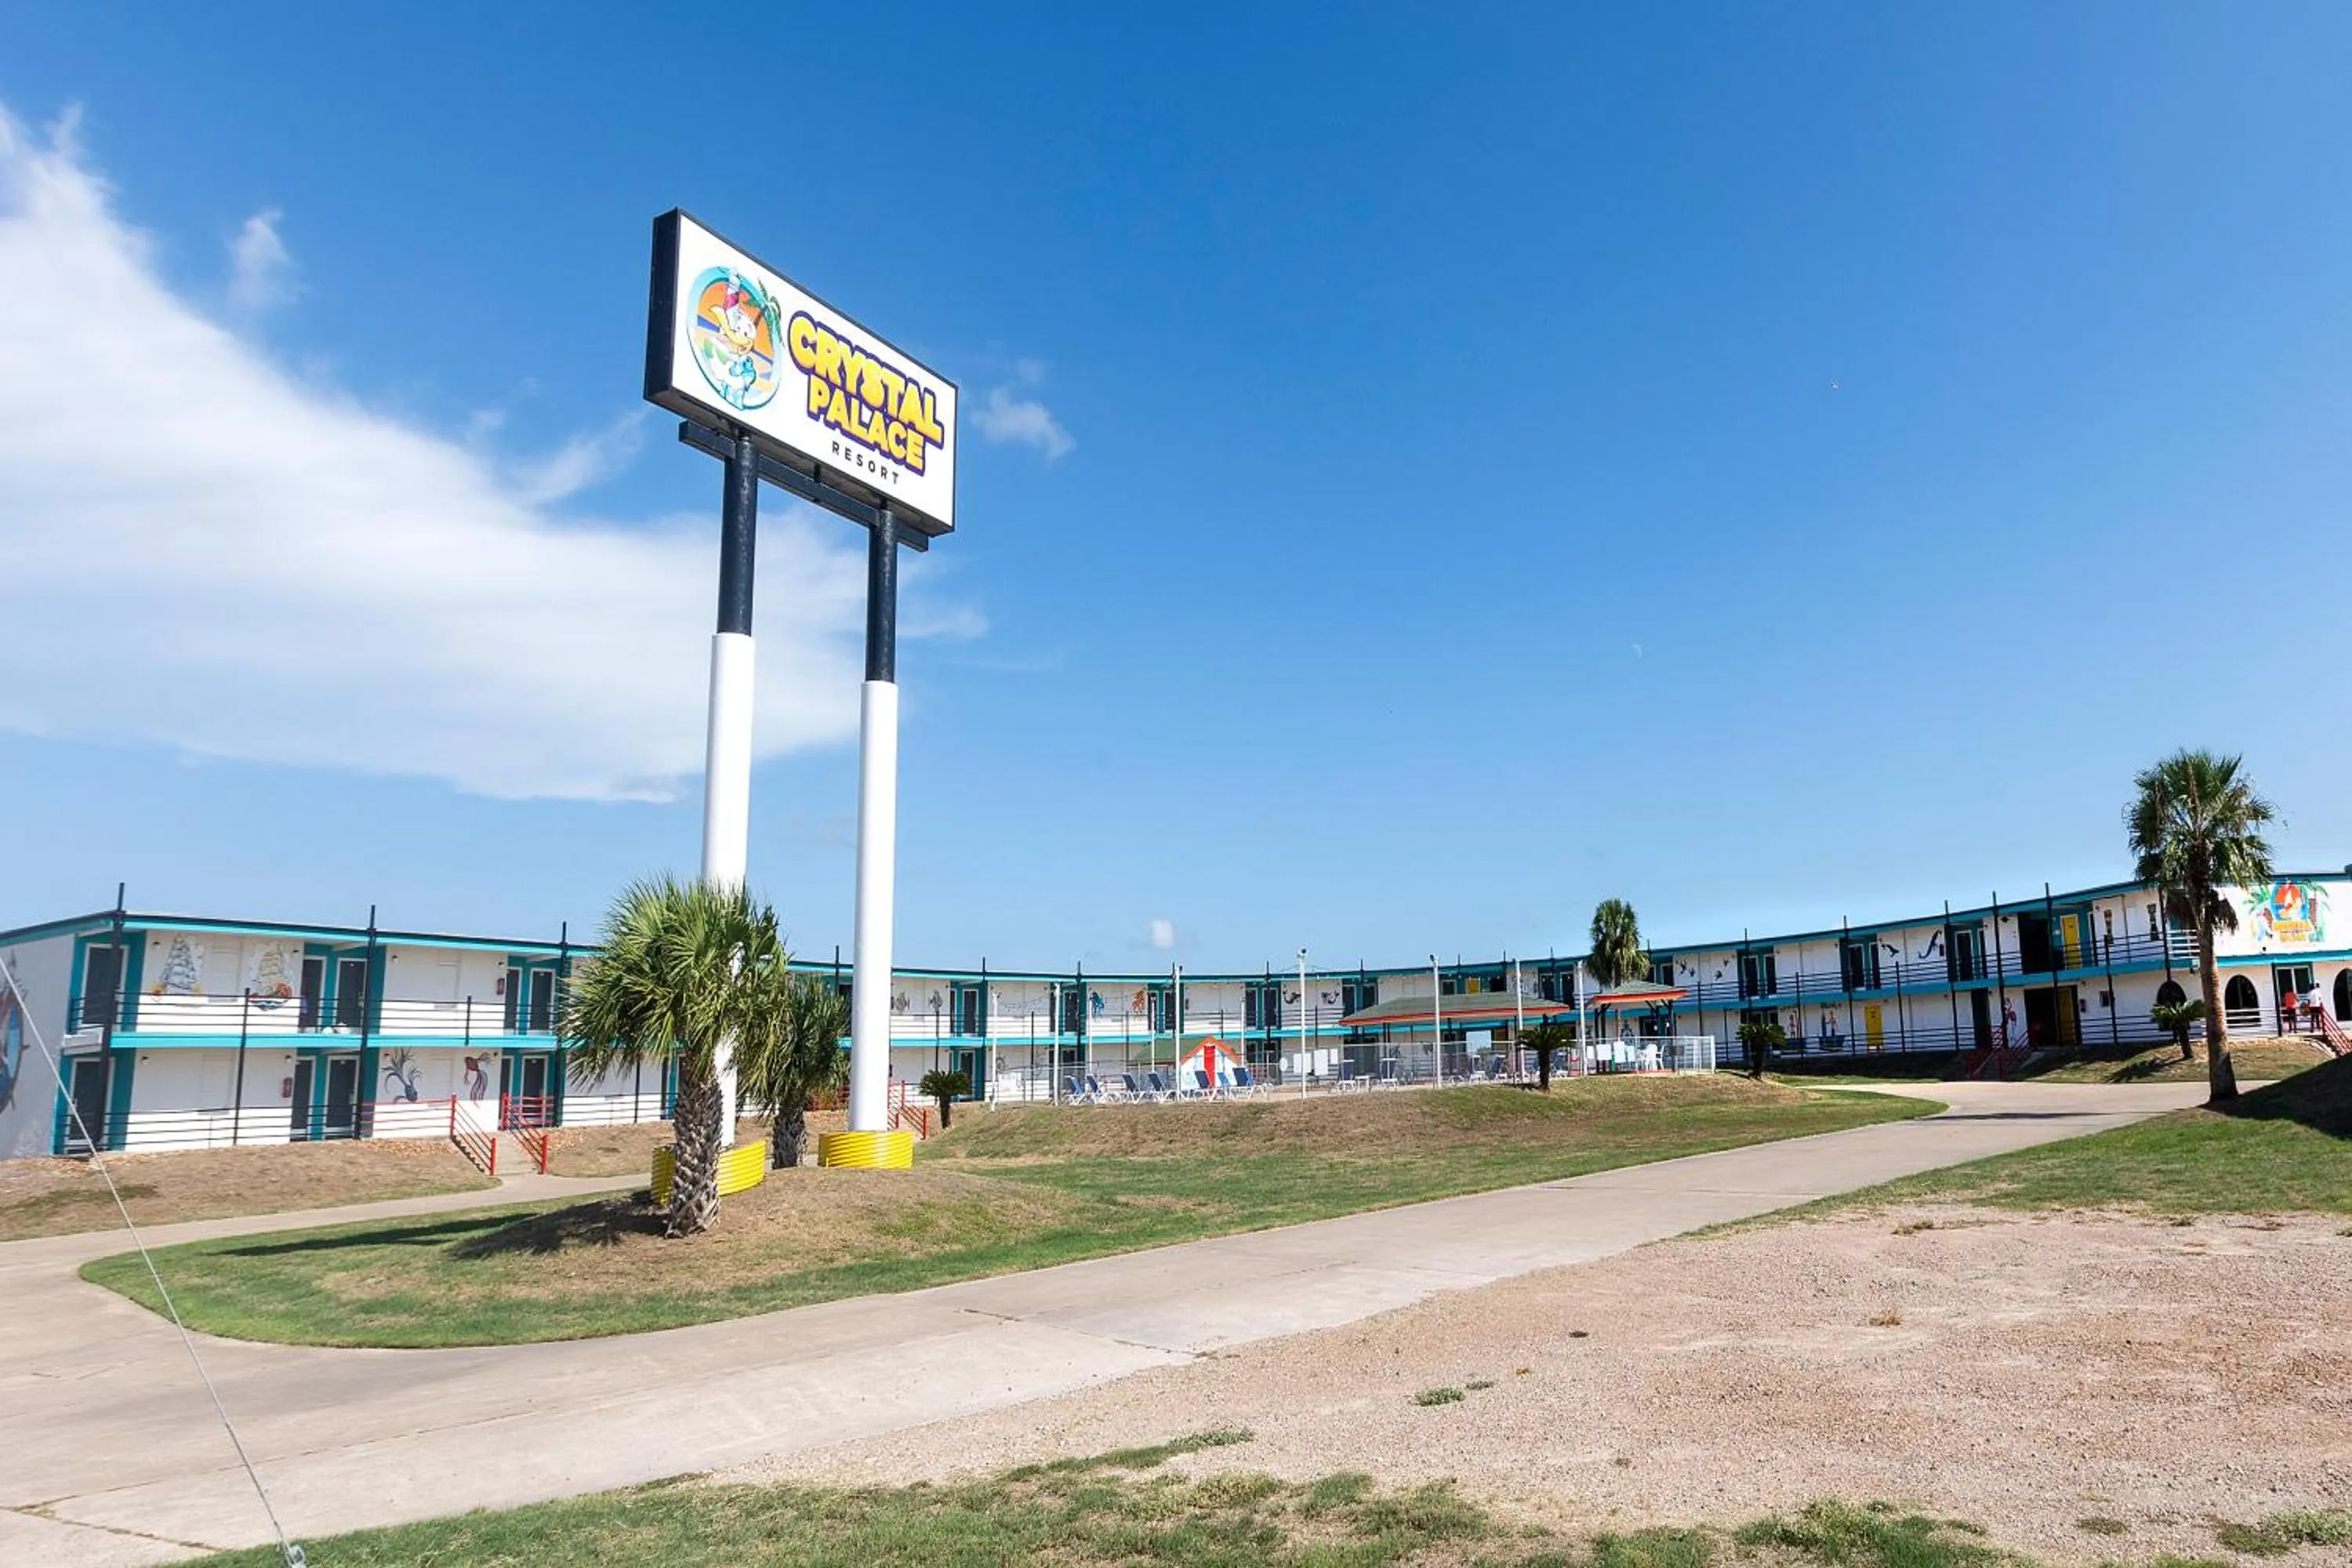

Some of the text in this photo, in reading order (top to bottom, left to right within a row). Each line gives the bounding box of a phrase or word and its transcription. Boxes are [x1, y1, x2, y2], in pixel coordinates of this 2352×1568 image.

[788, 310, 944, 449] CRYSTAL
[808, 374, 925, 477] PALACE
[832, 441, 900, 485] RESORT
